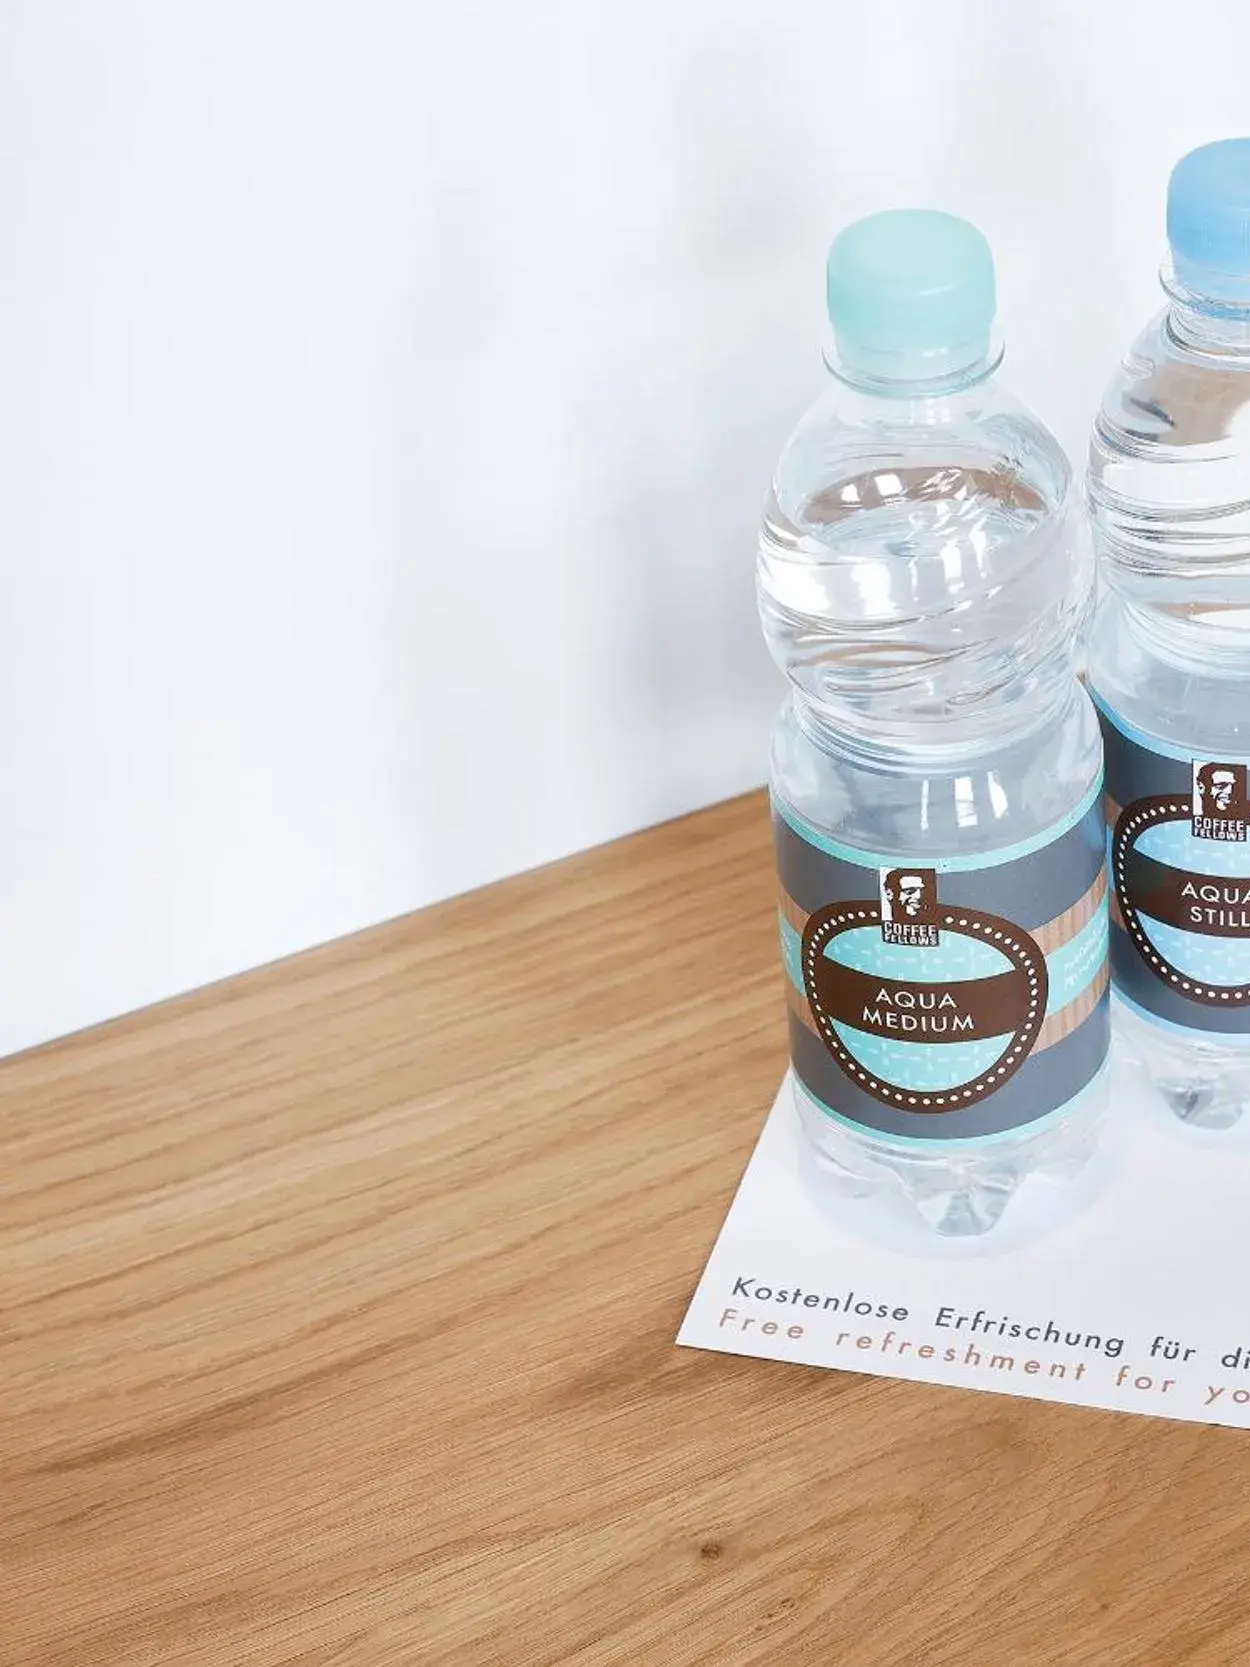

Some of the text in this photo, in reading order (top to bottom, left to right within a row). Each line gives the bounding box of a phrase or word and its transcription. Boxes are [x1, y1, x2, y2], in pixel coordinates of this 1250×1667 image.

[1194, 816, 1244, 832] COFFEE
[1194, 828, 1244, 841] FELLOWS
[1190, 906, 1250, 928] STILL
[884, 921, 937, 937] COFFEE
[884, 932, 938, 946] FELLOWS
[875, 987, 957, 1009] AQUA
[862, 1008, 975, 1032] MEDIUM
[732, 1276, 910, 1322] Kostenlose
[934, 1306, 1124, 1358] Erfrischung
[1150, 1336, 1197, 1362] für
[719, 1307, 805, 1339] Free
[835, 1330, 1087, 1381] refreshment
[1115, 1365, 1176, 1393] for
